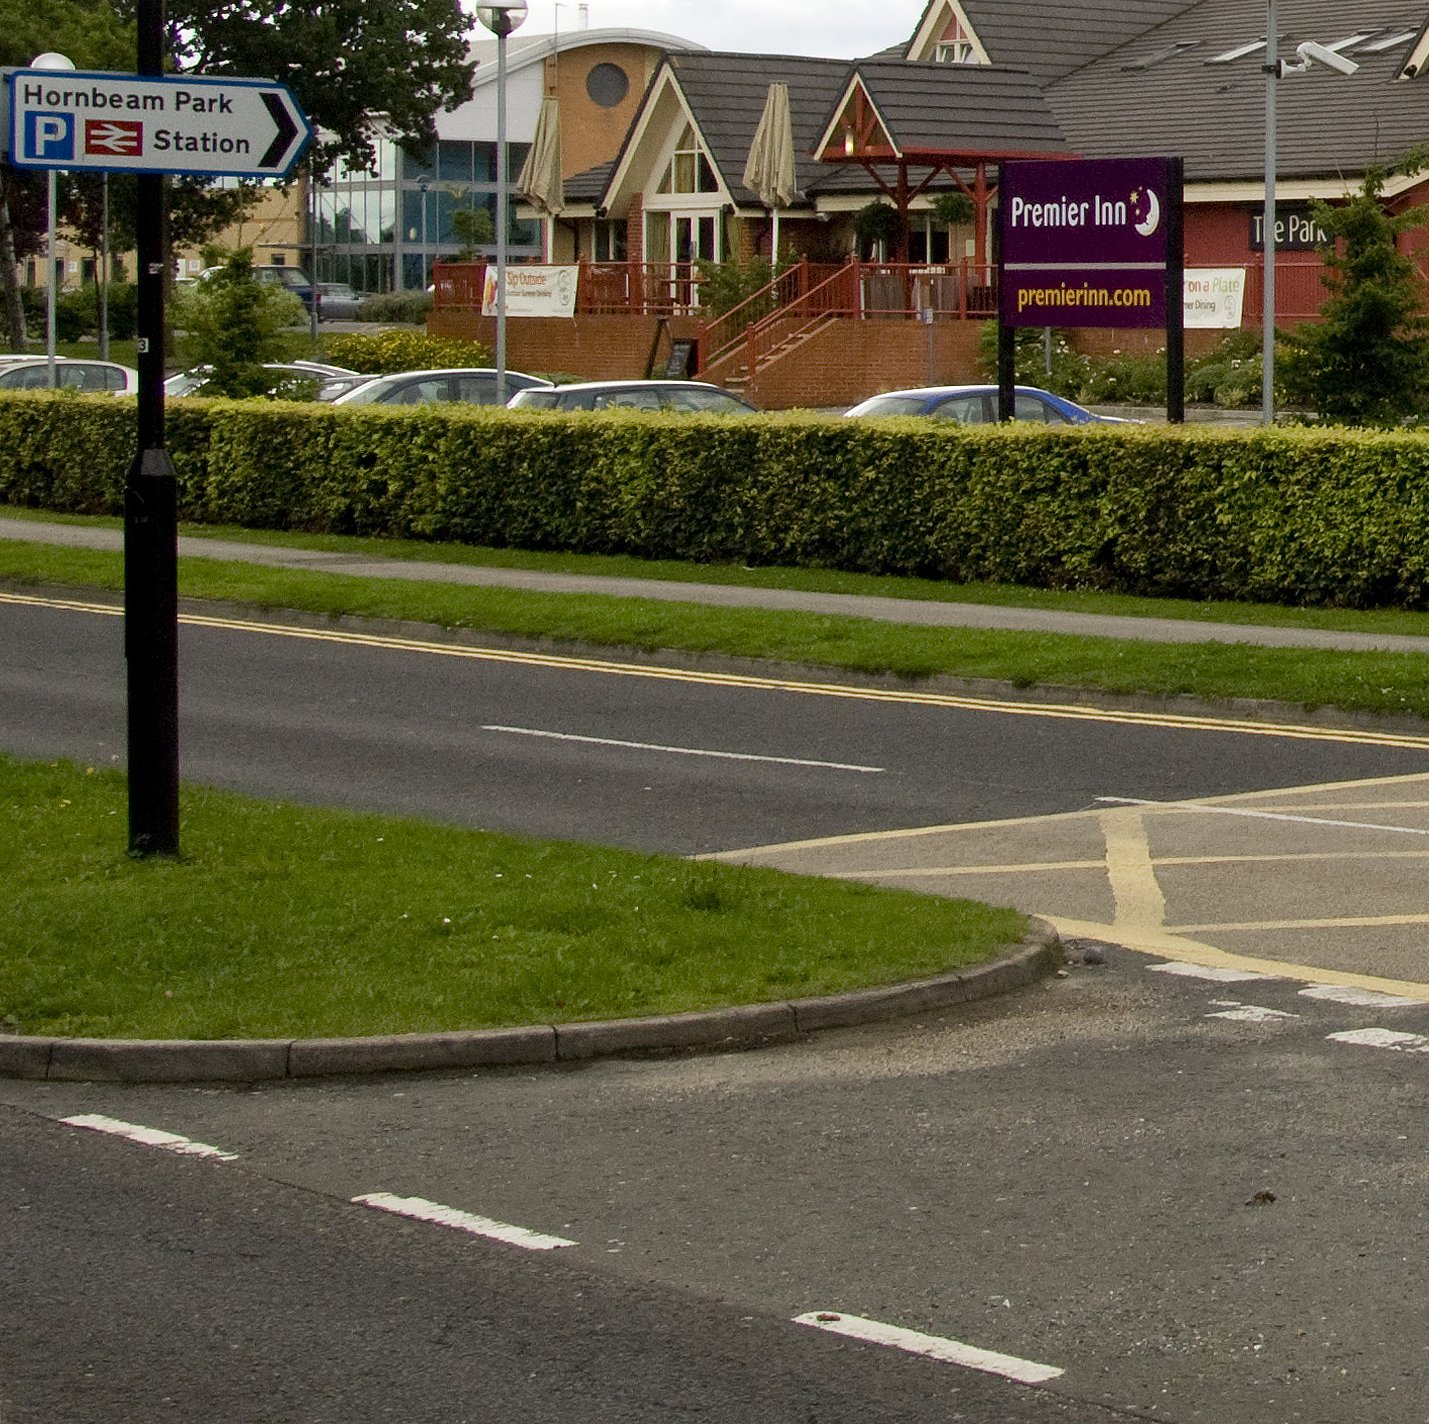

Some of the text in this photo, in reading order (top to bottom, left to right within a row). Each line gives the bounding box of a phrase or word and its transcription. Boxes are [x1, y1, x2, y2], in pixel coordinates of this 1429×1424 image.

[24, 84, 233, 114] Hornbeam Park
[154, 130, 250, 154] Station
[1012, 195, 1127, 227] Premier Inn
[1253, 213, 1284, 243] Te
[1018, 282, 1151, 313] premierinn.com
[1203, 280, 1210, 292] a
[1212, 275, 1239, 293] Plate
